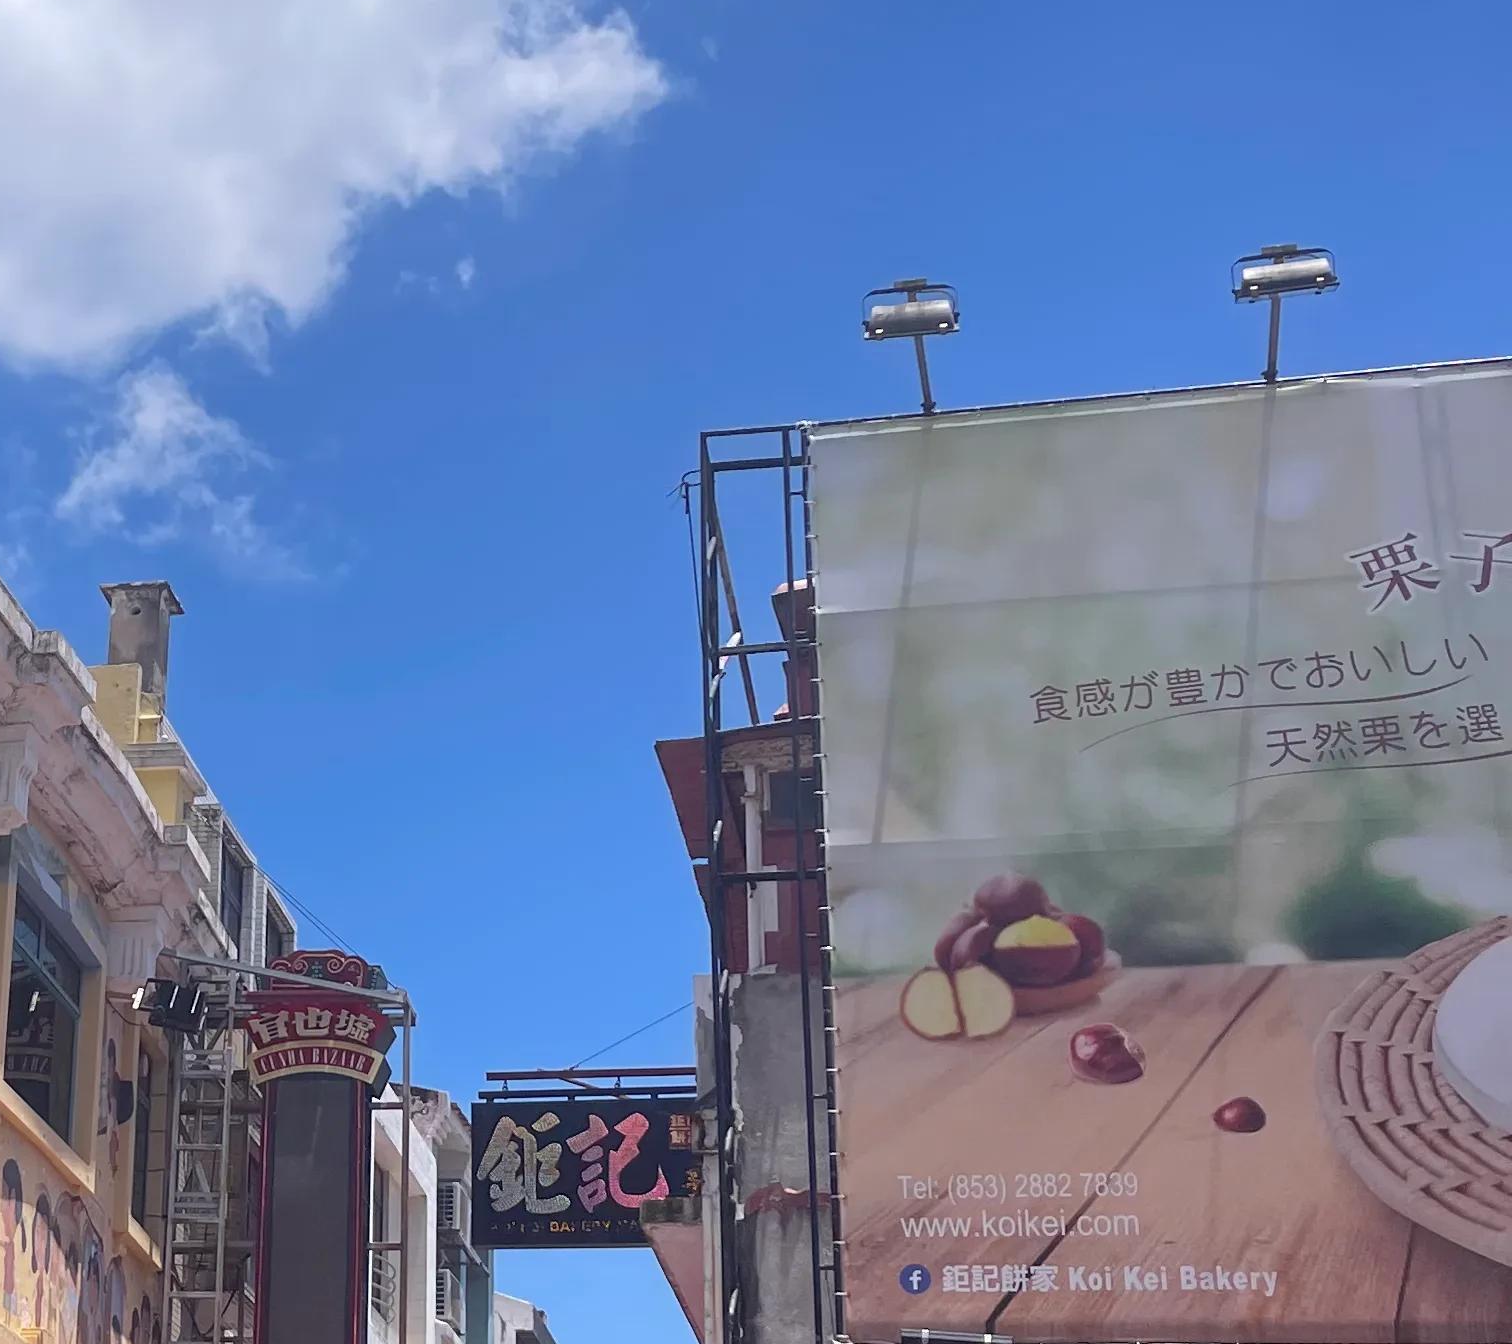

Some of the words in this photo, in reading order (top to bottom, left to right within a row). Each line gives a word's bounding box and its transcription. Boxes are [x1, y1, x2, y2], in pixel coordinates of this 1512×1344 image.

[1029, 632, 1489, 724] 食感が豊かでおいしい
[1265, 703, 1505, 768] 天然栗を選
[476, 1111, 670, 1214] 鉅記
[898, 1174, 940, 1200] Tel:
[947, 1172, 1008, 1205] (853)
[1014, 1172, 1073, 1199] 2882
[1082, 1171, 1139, 1198] 7839
[900, 1209, 1140, 1239] www.koikei.com
[942, 1263, 1059, 1293] 鉅記餅家
[1069, 1266, 1113, 1292] Koi
[1124, 1265, 1169, 1291] Kei
[1180, 1265, 1278, 1298] Bakery
